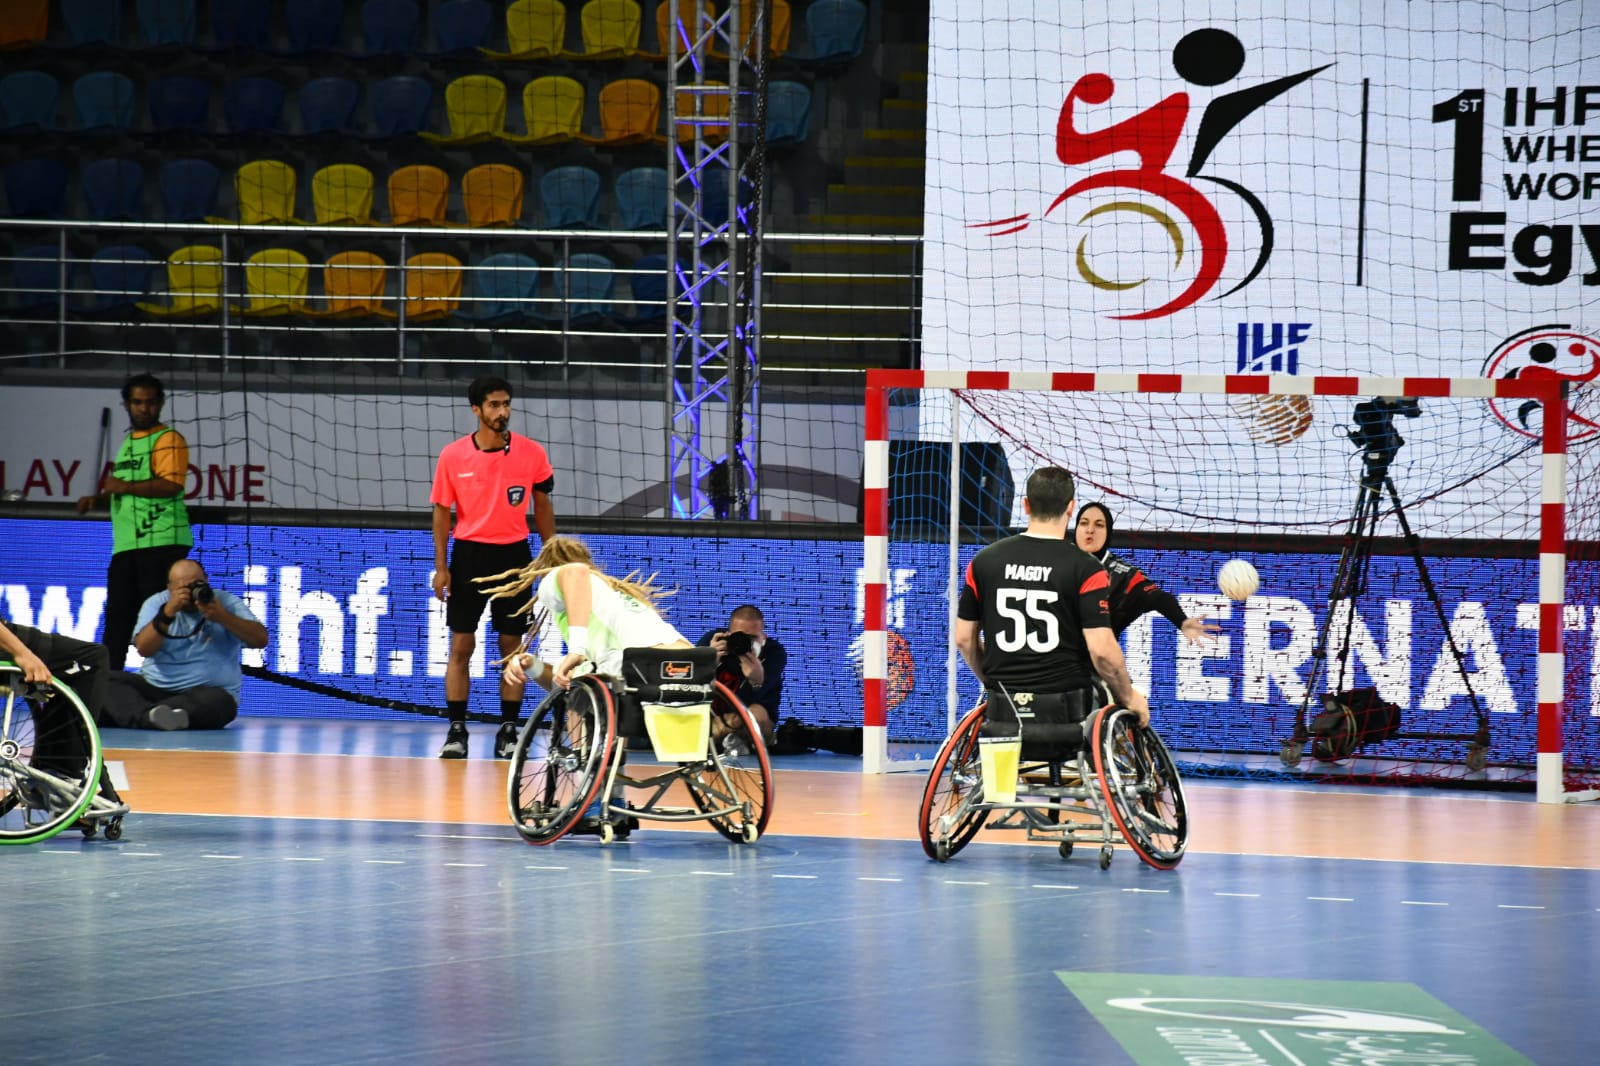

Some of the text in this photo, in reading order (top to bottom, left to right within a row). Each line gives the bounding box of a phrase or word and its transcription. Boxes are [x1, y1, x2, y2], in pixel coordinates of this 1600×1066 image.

[1504, 86, 1600, 127] IHF
[1502, 135, 1600, 163] WHE
[1237, 322, 1313, 376] IHF
[1005, 564, 1052, 582] MAGDY
[995, 587, 1060, 653] 55
